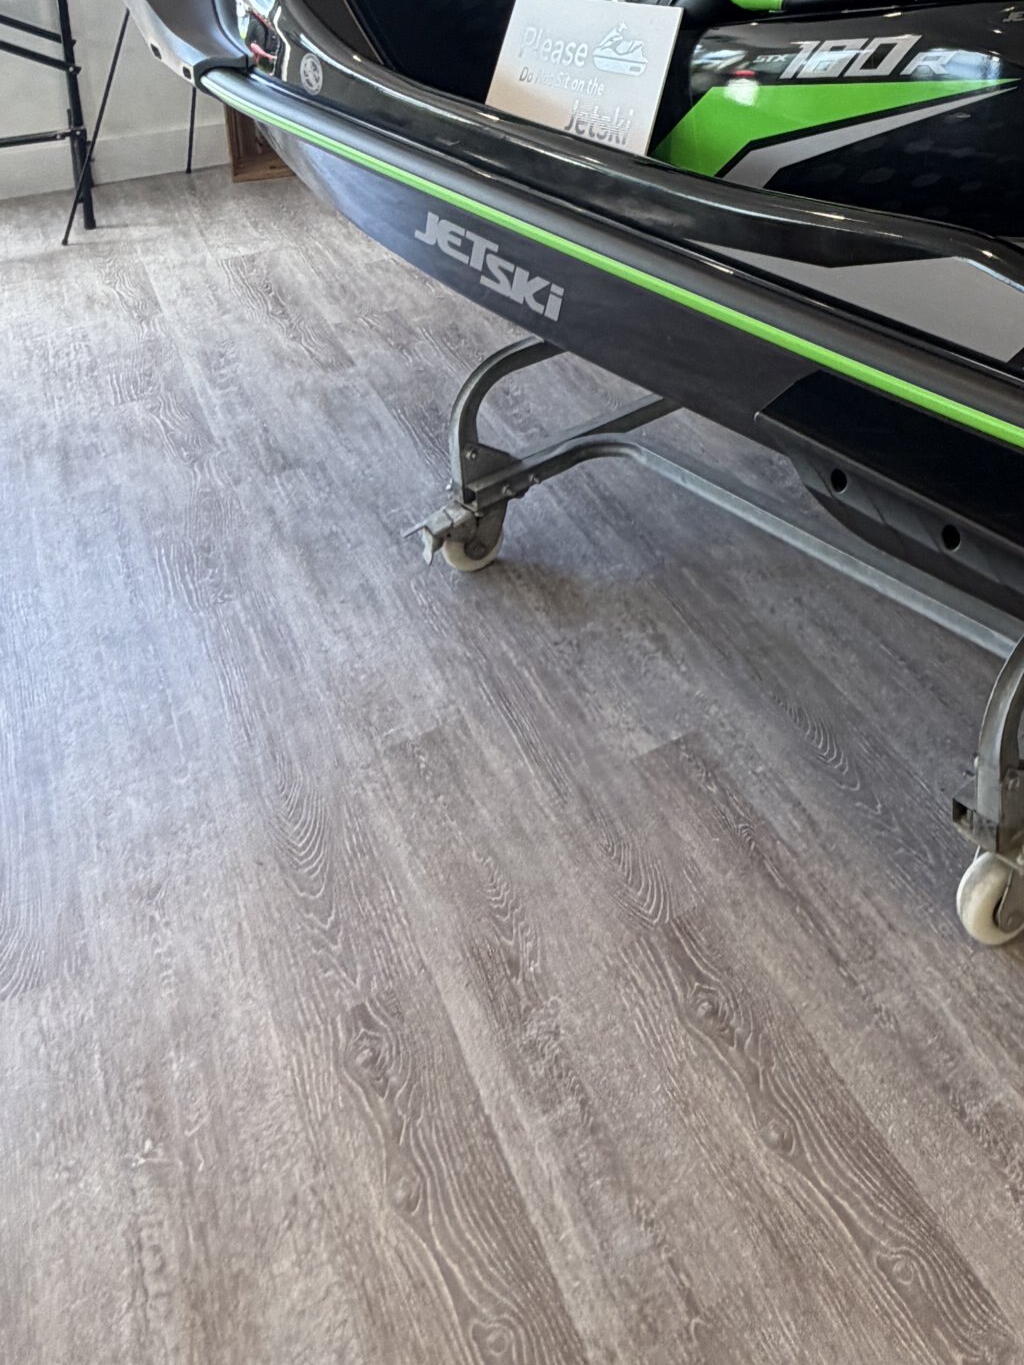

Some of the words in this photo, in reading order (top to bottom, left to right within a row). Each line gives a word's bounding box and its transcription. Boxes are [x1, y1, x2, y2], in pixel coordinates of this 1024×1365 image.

[518, 26, 589, 68] Please
[753, 54, 788, 64] STX
[519, 66, 534, 83] Do
[571, 78, 586, 93] on
[586, 77, 605, 96] the
